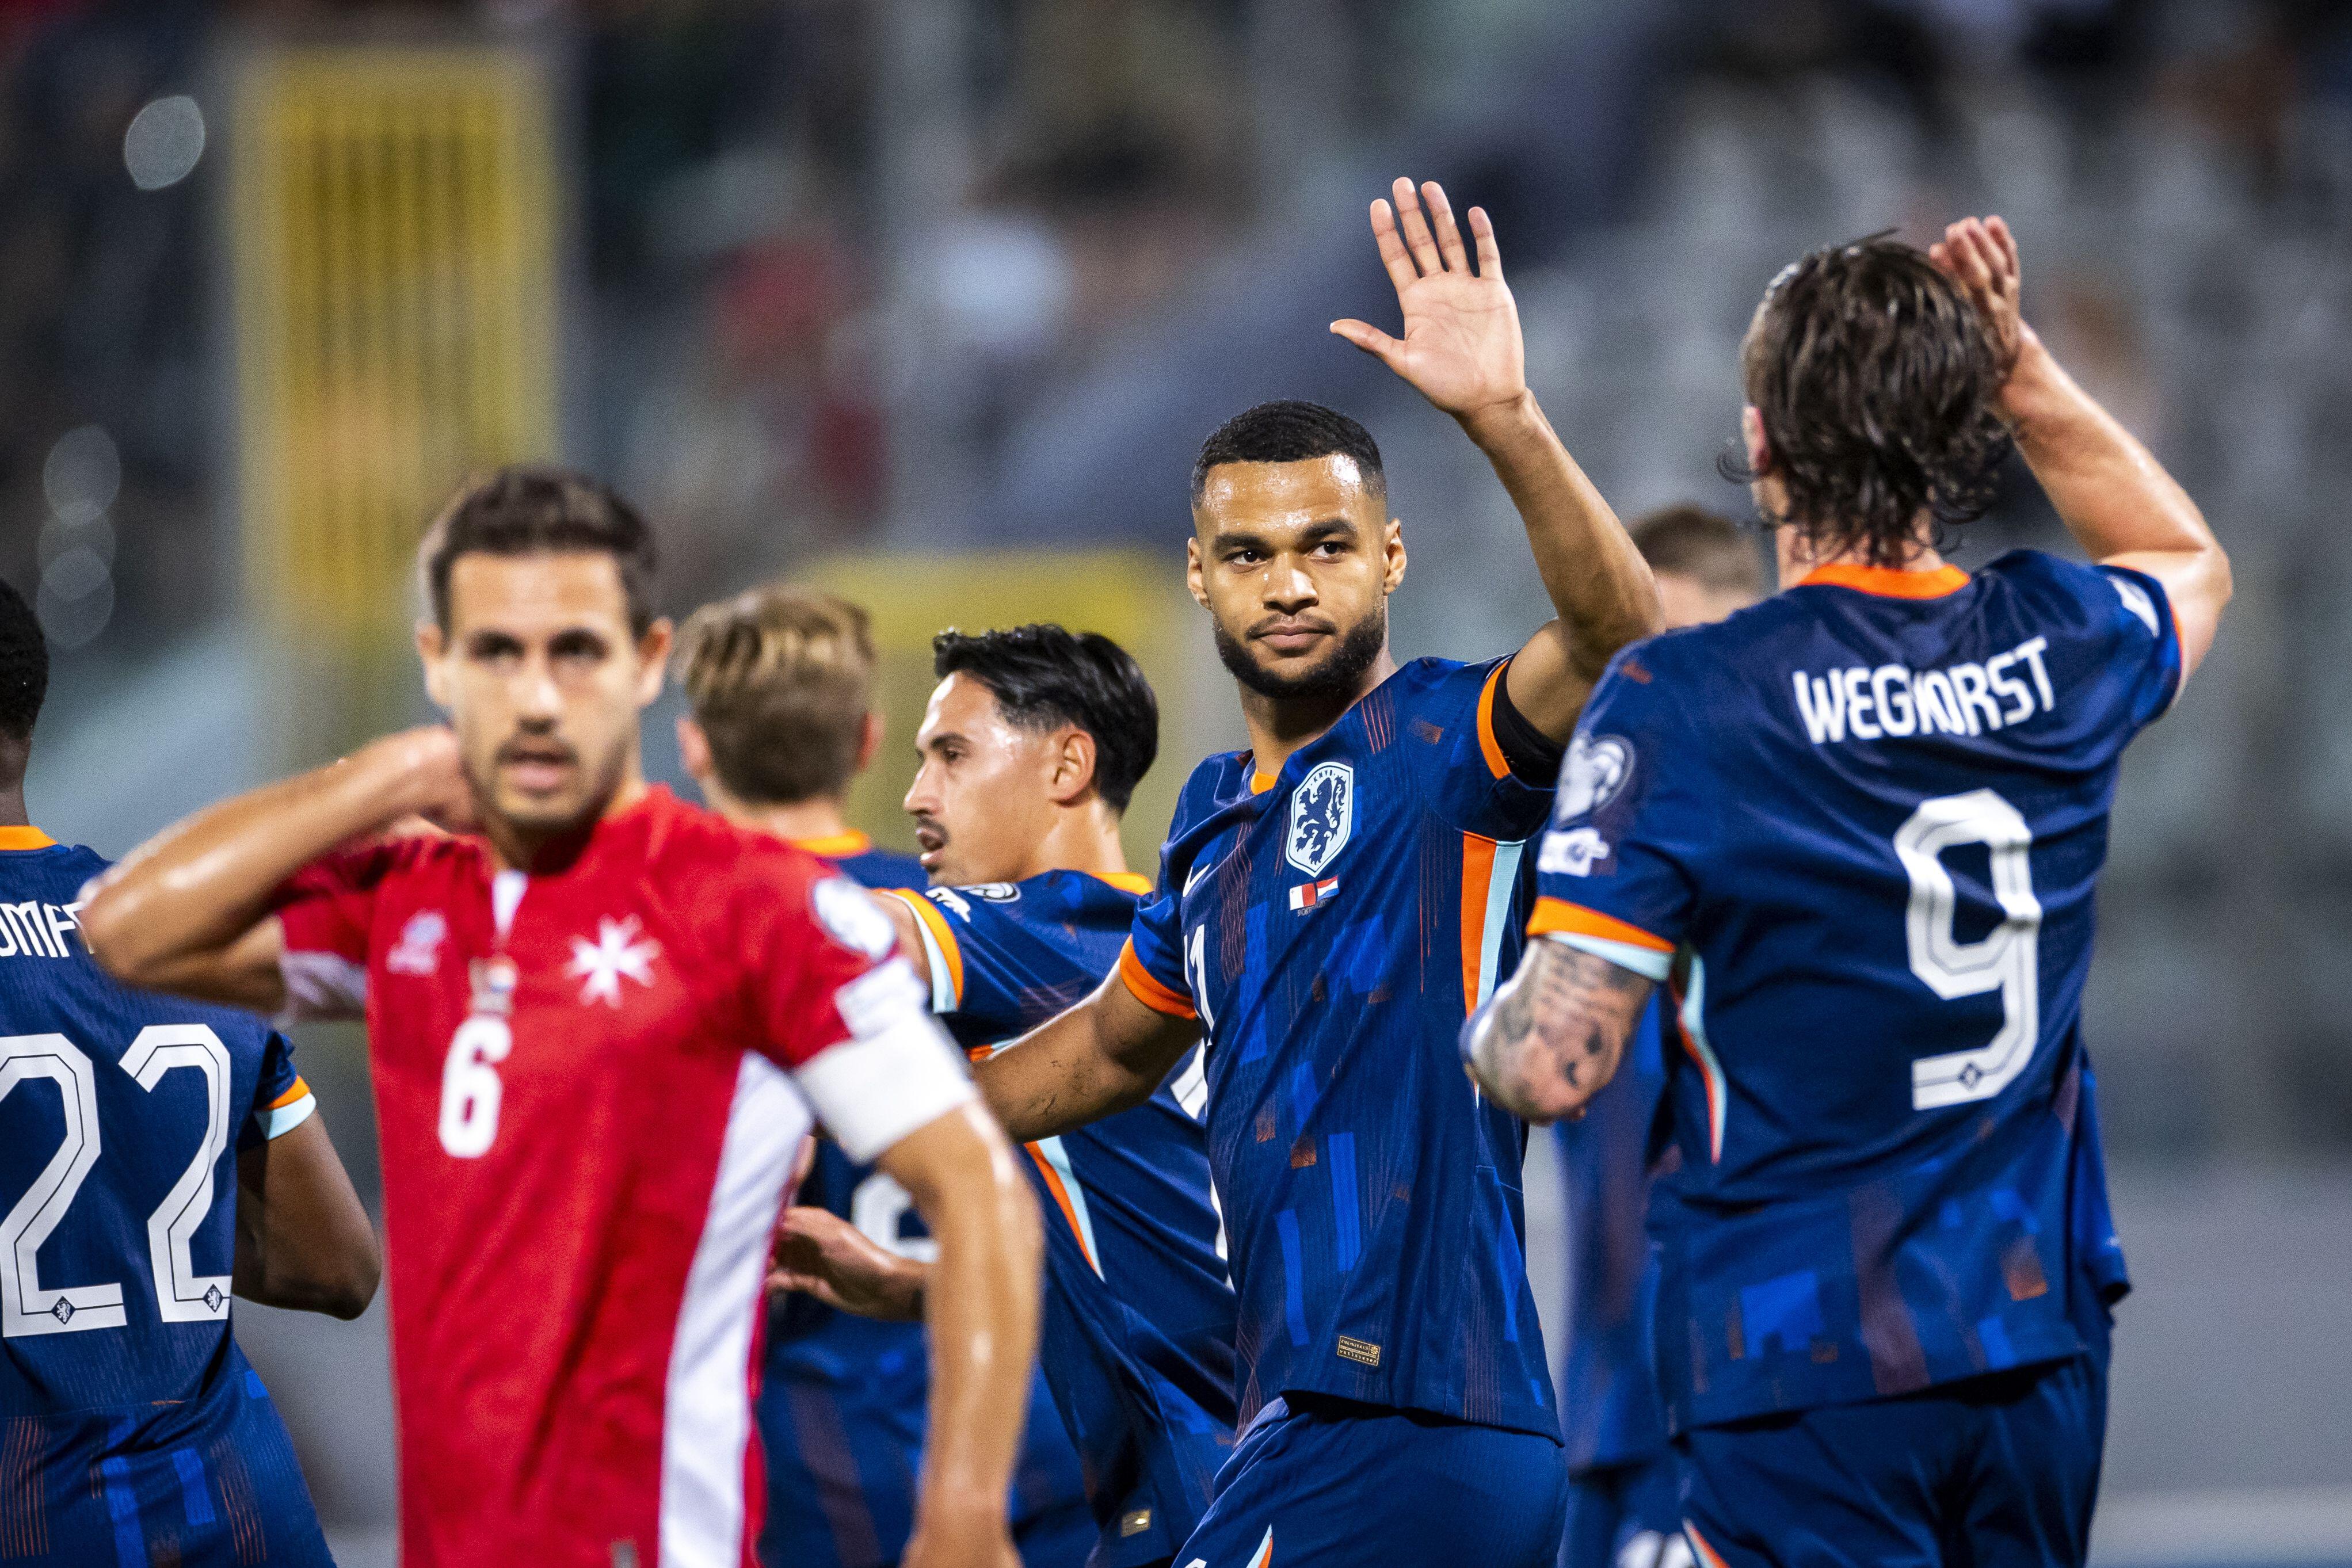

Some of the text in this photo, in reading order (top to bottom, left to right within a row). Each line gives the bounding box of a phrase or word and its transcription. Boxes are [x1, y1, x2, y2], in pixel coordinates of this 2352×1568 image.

[1183, 924, 1214, 1033] 1
[1893, 789, 2042, 1111] 9
[0, 1024, 232, 1338] 22
[438, 1016, 514, 1159] 6
